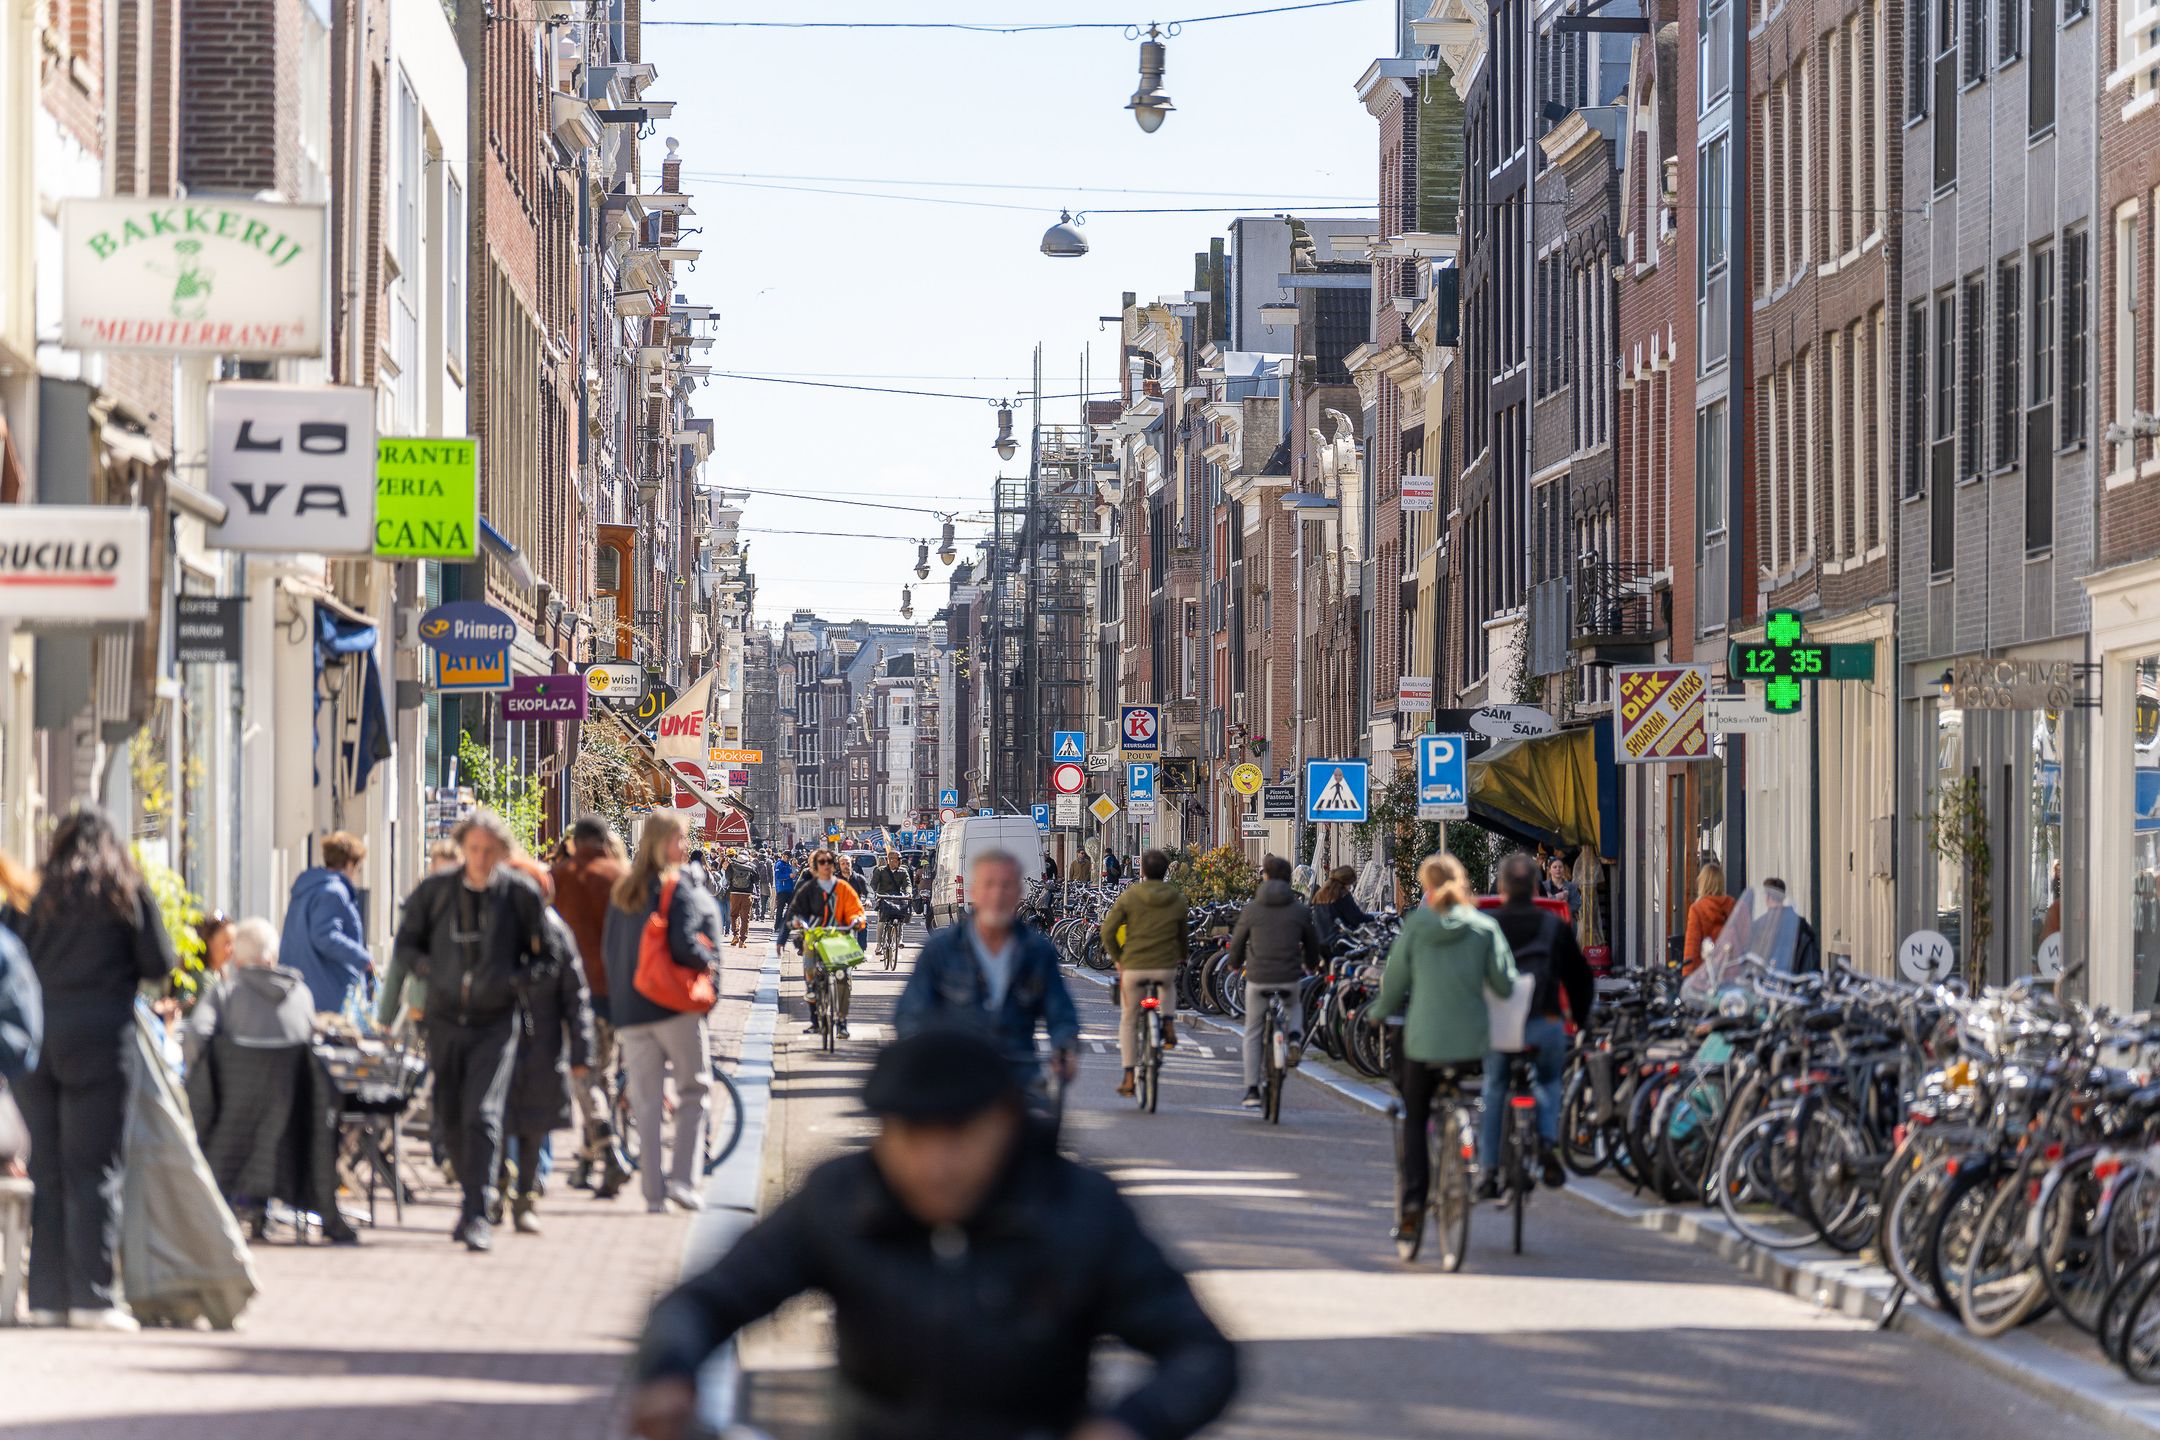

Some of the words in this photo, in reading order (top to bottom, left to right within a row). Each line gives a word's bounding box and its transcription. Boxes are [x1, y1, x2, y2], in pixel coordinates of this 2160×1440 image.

[87, 206, 304, 269] BAKKERIJ
[235, 420, 348, 454] LO
[231, 482, 349, 517] VA
[454, 619, 514, 640] Primera
[445, 653, 500, 671] ATM
[1746, 650, 1775, 672] 12
[1790, 650, 1822, 672] 35
[590, 676, 609, 687] eye
[612, 675, 638, 685] wish
[1620, 672, 1644, 697] DE
[1960, 662, 2072, 687] ARCHIVE
[508, 698, 577, 711] EKOPLAZA
[1622, 671, 1670, 722] DIJK
[1957, 686, 2012, 708] 1906
[660, 709, 704, 736] UMÉ
[1480, 706, 1511, 720] SAM
[1625, 711, 1668, 758] SHOARMA
[1667, 670, 1703, 713] SNACKS
[1749, 715, 1768, 723] Yarn
[1129, 718, 1150, 737] K
[1512, 724, 1543, 736] SAM
[1090, 756, 1107, 768] Etos
[1127, 752, 1152, 760] POUW
[1429, 741, 1454, 776] P
[1134, 767, 1149, 786] P
[1036, 807, 1045, 820] P
